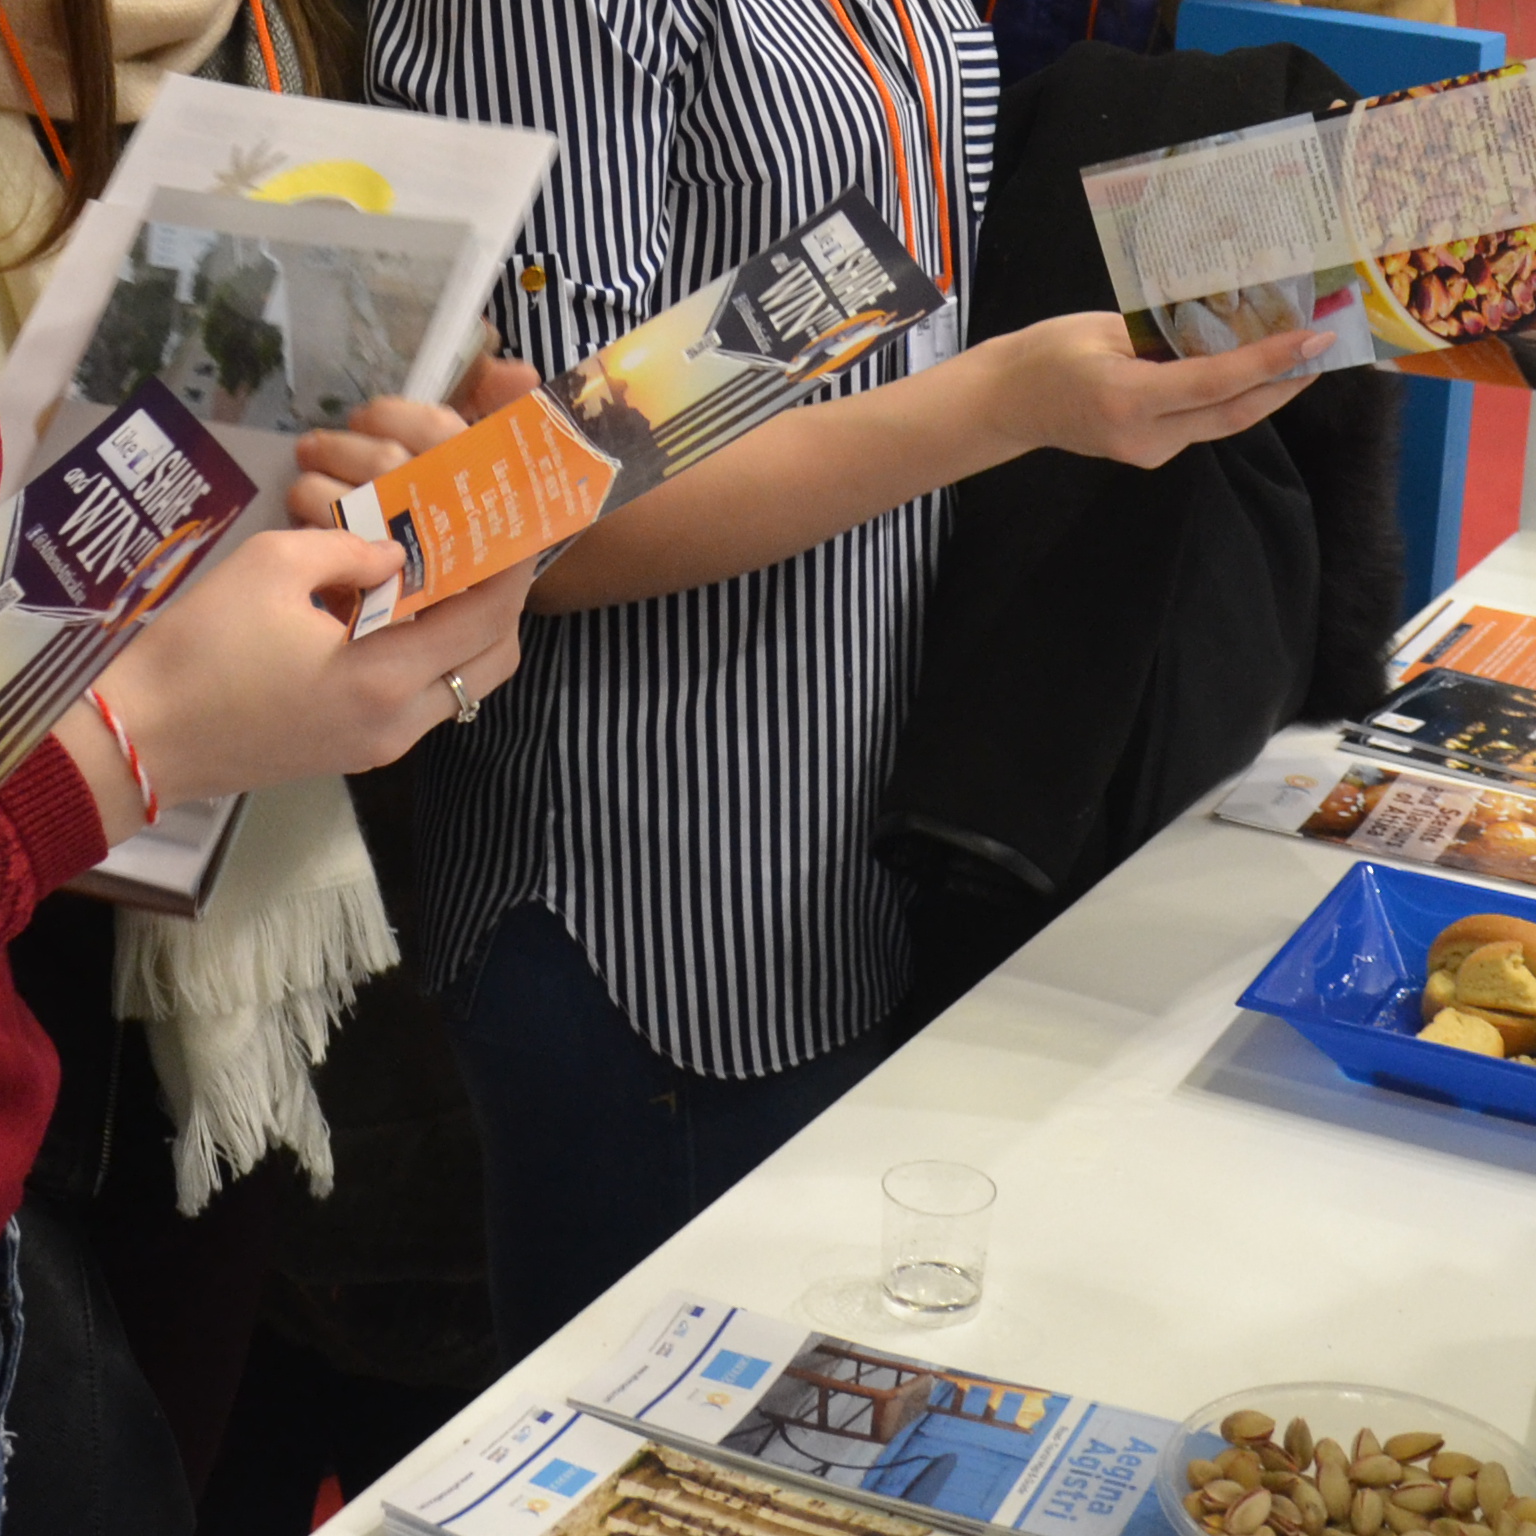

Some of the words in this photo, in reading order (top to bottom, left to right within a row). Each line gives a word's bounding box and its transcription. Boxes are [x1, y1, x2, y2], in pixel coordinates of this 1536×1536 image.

[825, 247, 896, 318] SHARE
[63, 467, 101, 494] and
[111, 427, 138, 459] Like
[134, 450, 211, 536] SHARE
[1392, 791, 1413, 805] of
[1413, 786, 1444, 809] and
[1365, 805, 1407, 838] Attica
[1384, 807, 1432, 848] flavours
[1417, 806, 1462, 844] Scents
[1044, 1438, 1116, 1522] Agistri
[1088, 1436, 1157, 1515] Aegina
